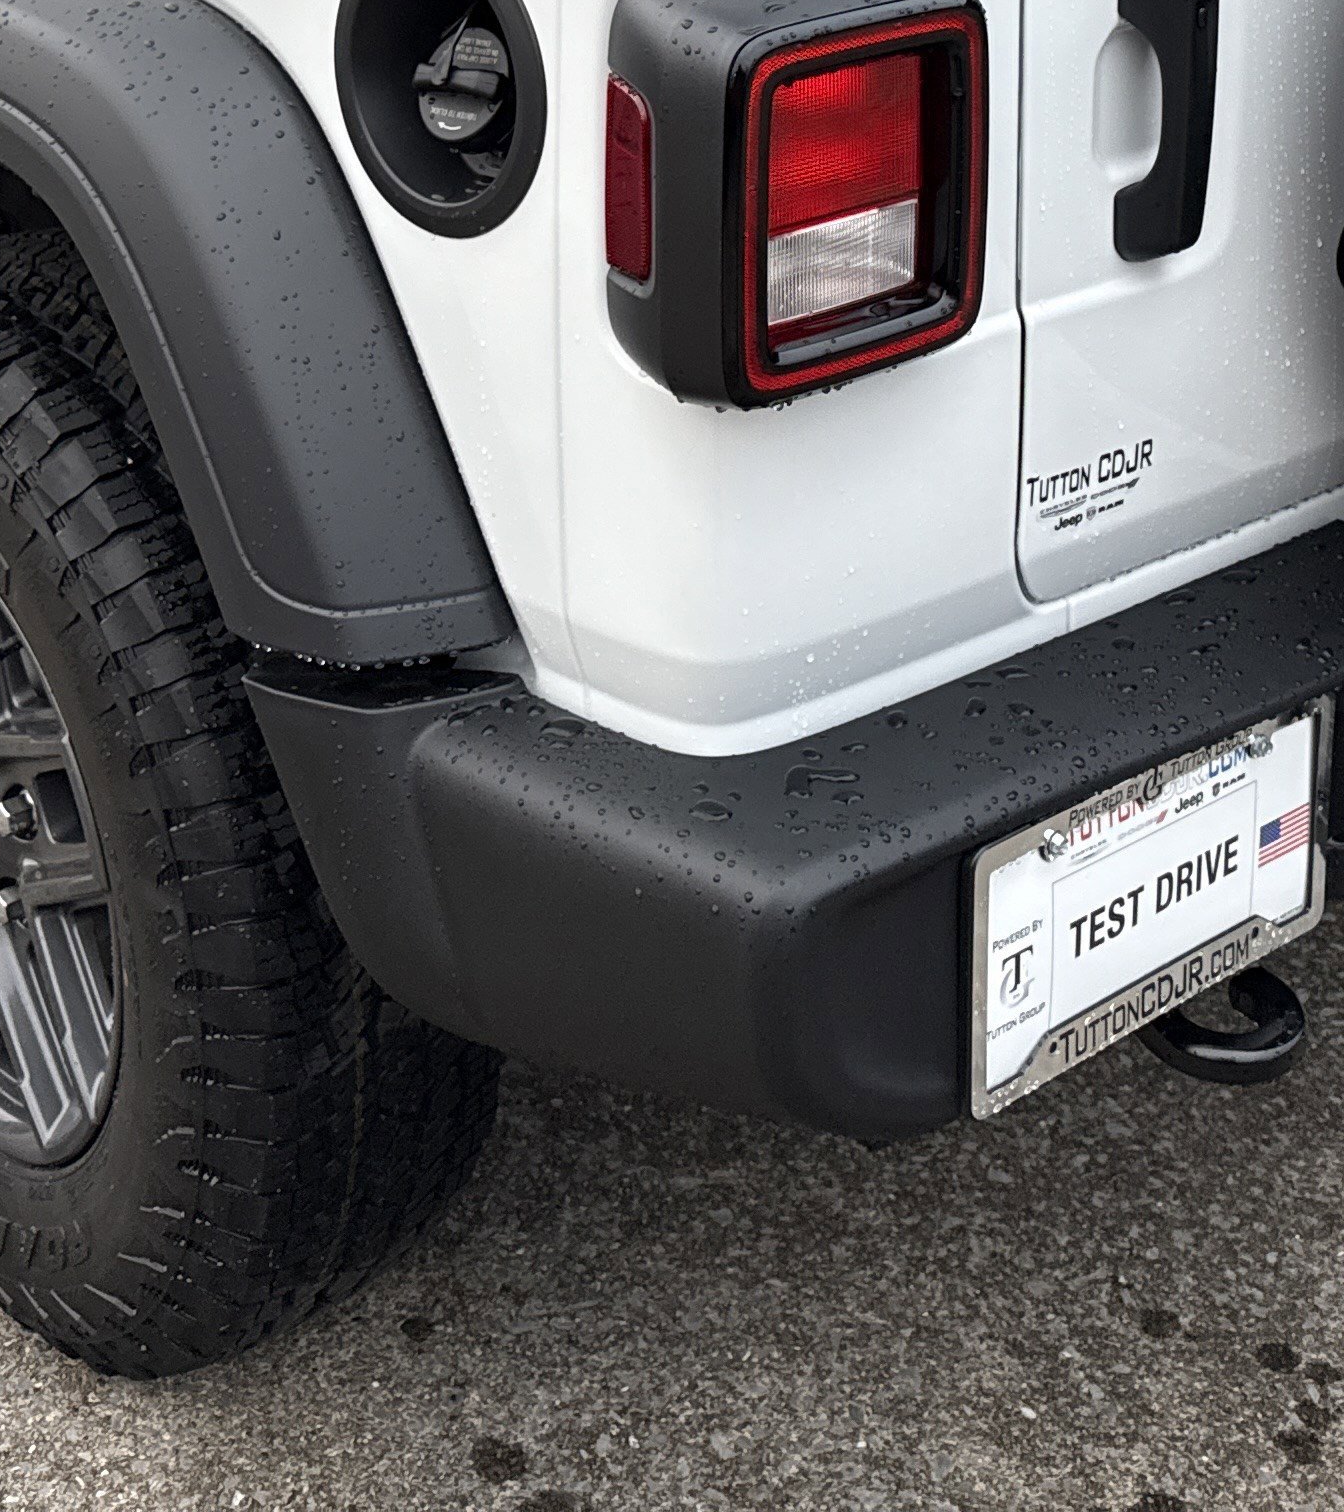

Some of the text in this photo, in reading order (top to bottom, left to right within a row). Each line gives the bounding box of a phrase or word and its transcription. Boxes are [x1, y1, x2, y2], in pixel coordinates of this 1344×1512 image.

[1026, 438, 1154, 507] TUTTON CDJR
[1054, 512, 1083, 531] Jeep
[1068, 788, 1123, 828] POWERED
[1126, 781, 1143, 800] BY
[1170, 746, 1213, 777] TUTTON
[1174, 791, 1204, 814] Jeep
[1069, 834, 1240, 959] TEST DRIVE
[992, 918, 1044, 953] POWERED BY
[1059, 933, 1251, 1064] TUTTONCDJR.COM
[986, 1018, 1018, 1042] TUTTON
